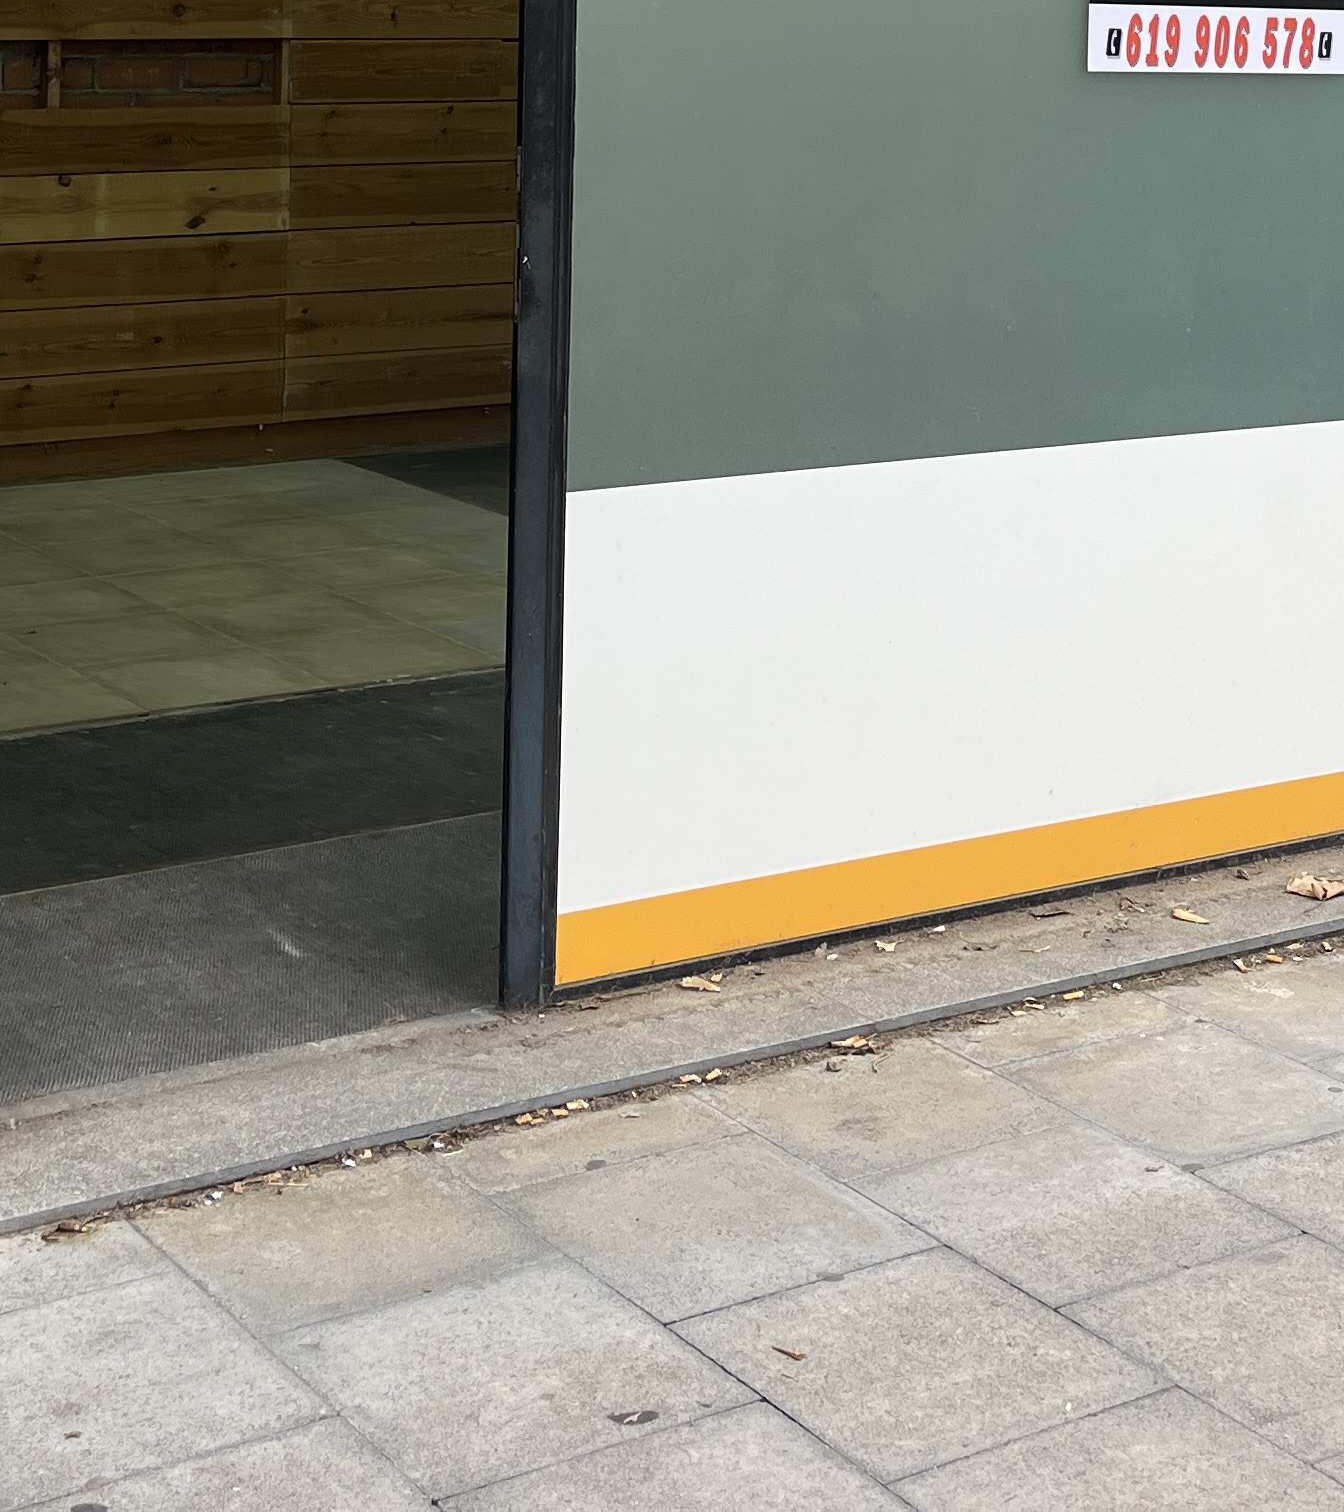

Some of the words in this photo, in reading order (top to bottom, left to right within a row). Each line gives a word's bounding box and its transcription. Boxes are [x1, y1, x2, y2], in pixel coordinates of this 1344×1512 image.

[1125, 12, 1182, 68] 619
[1194, 14, 1251, 69] 906
[1262, 16, 1316, 70] 578
